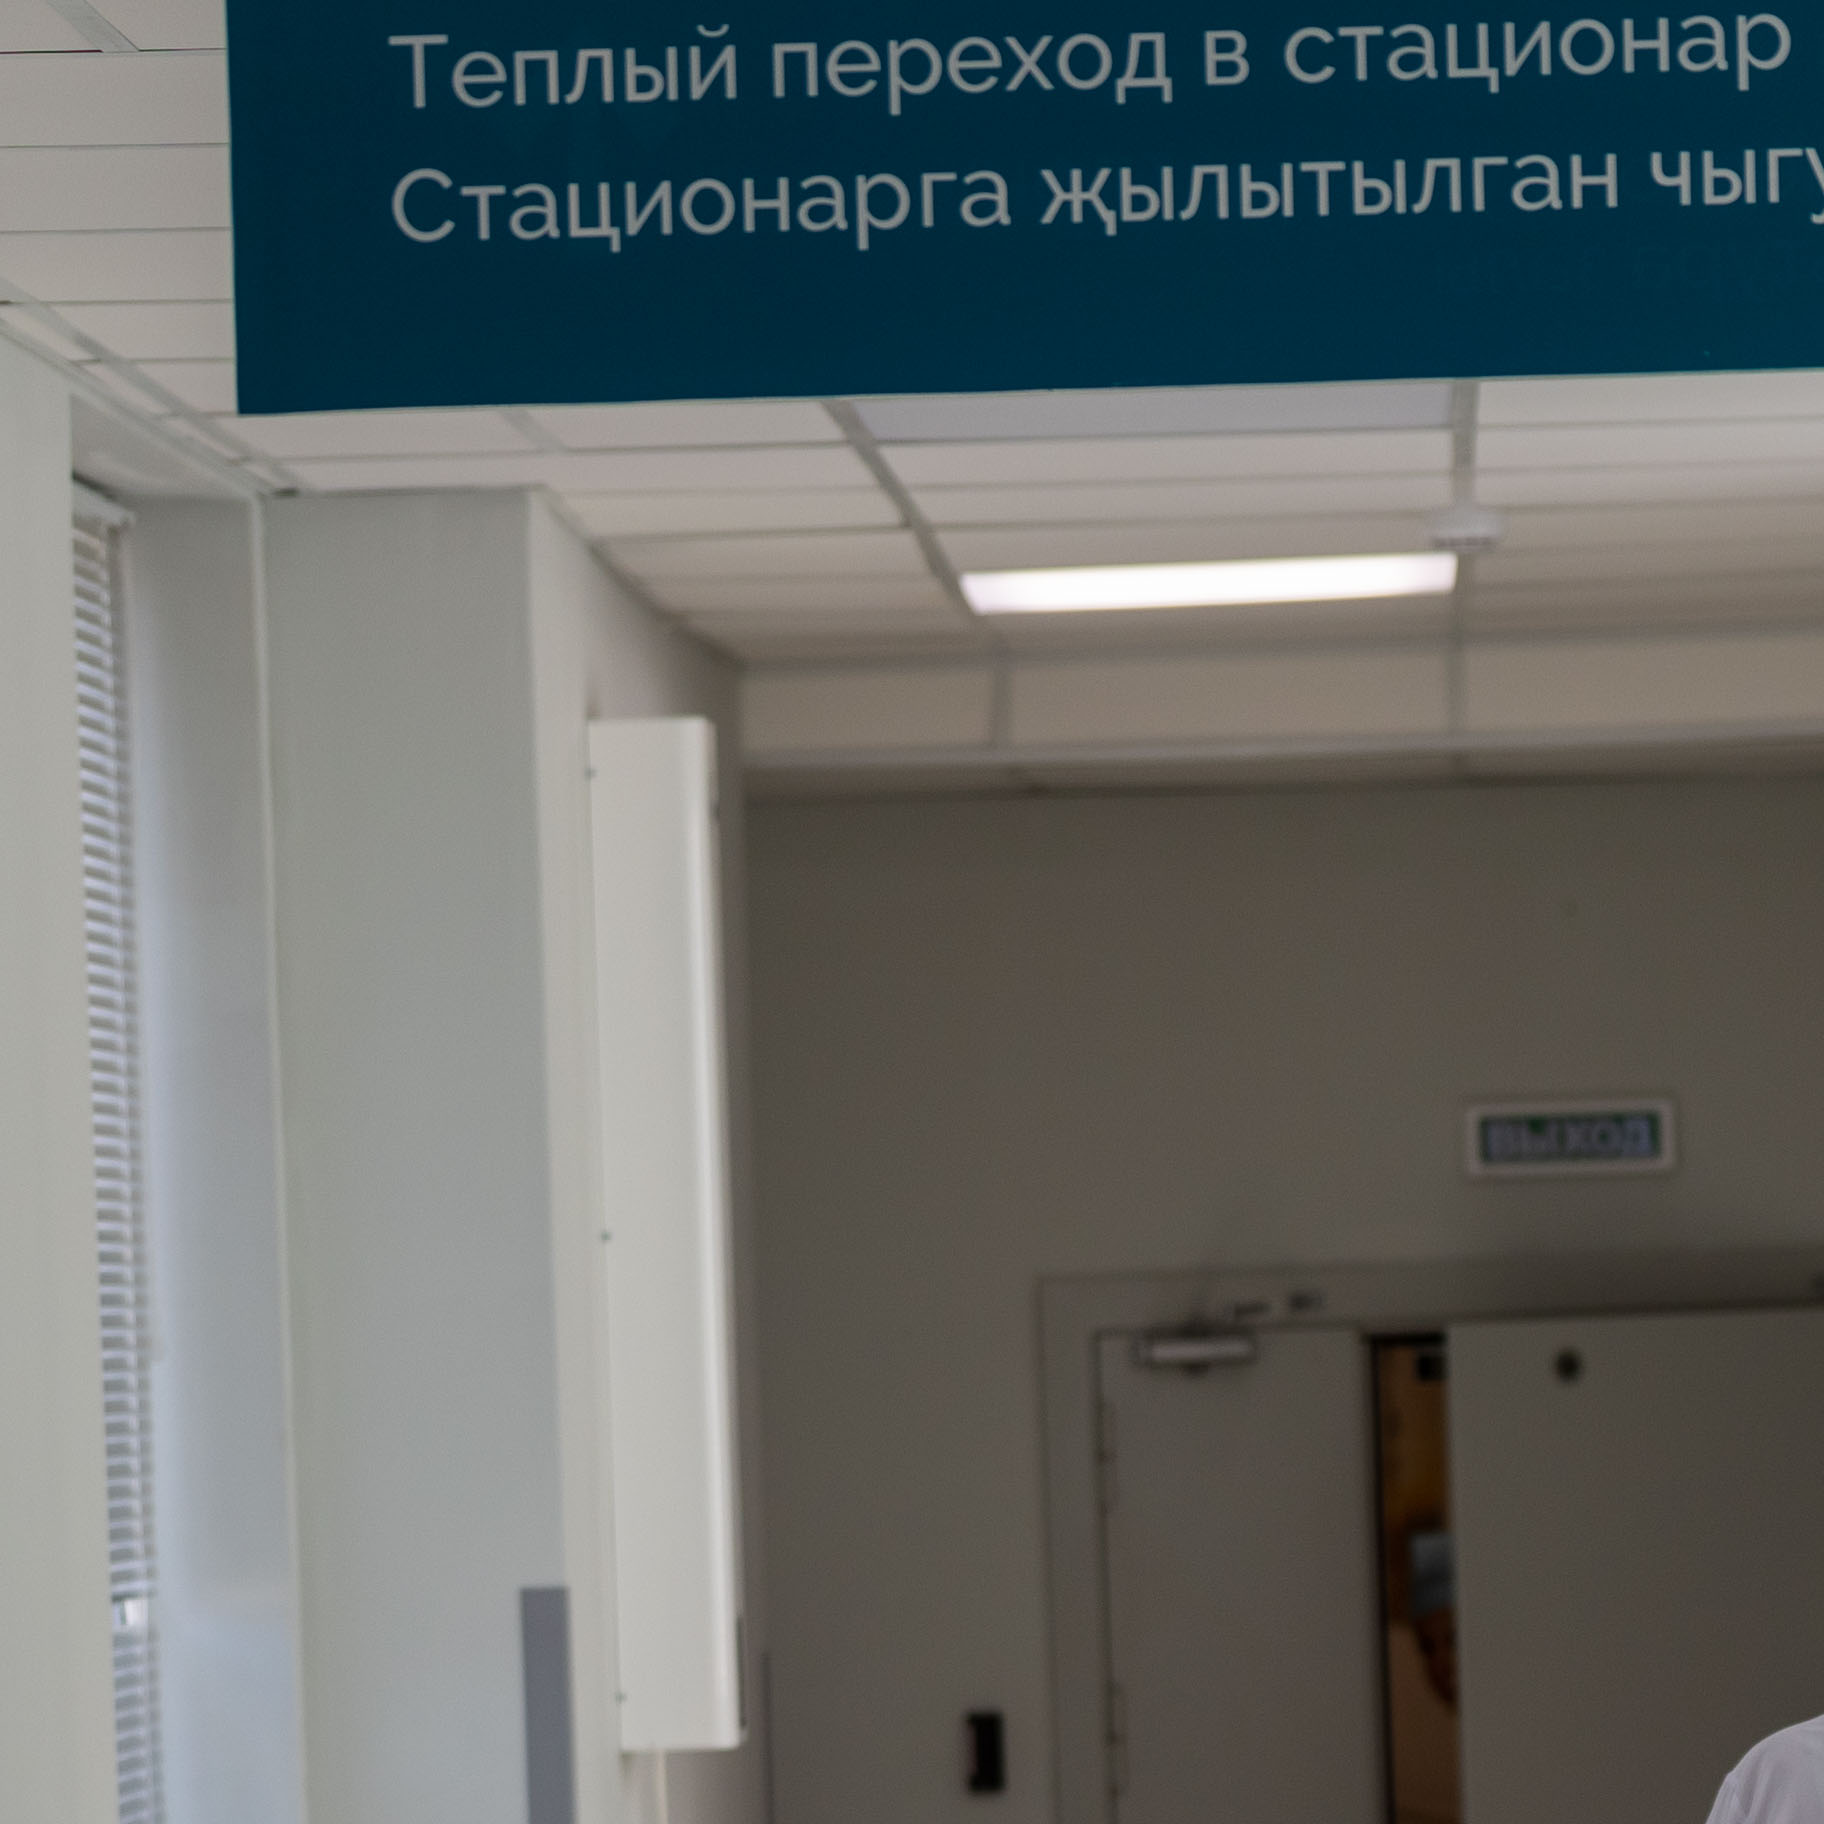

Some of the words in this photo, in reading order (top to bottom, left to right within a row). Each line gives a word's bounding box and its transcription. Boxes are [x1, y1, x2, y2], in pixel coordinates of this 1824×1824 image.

[388, 23, 737, 108] Теплый
[773, 33, 1173, 116] переход
[1205, 30, 1250, 86] в
[1285, 13, 1792, 93] стационар
[390, 168, 1012, 253] Стационарга
[1040, 154, 1618, 236] җылытылган
